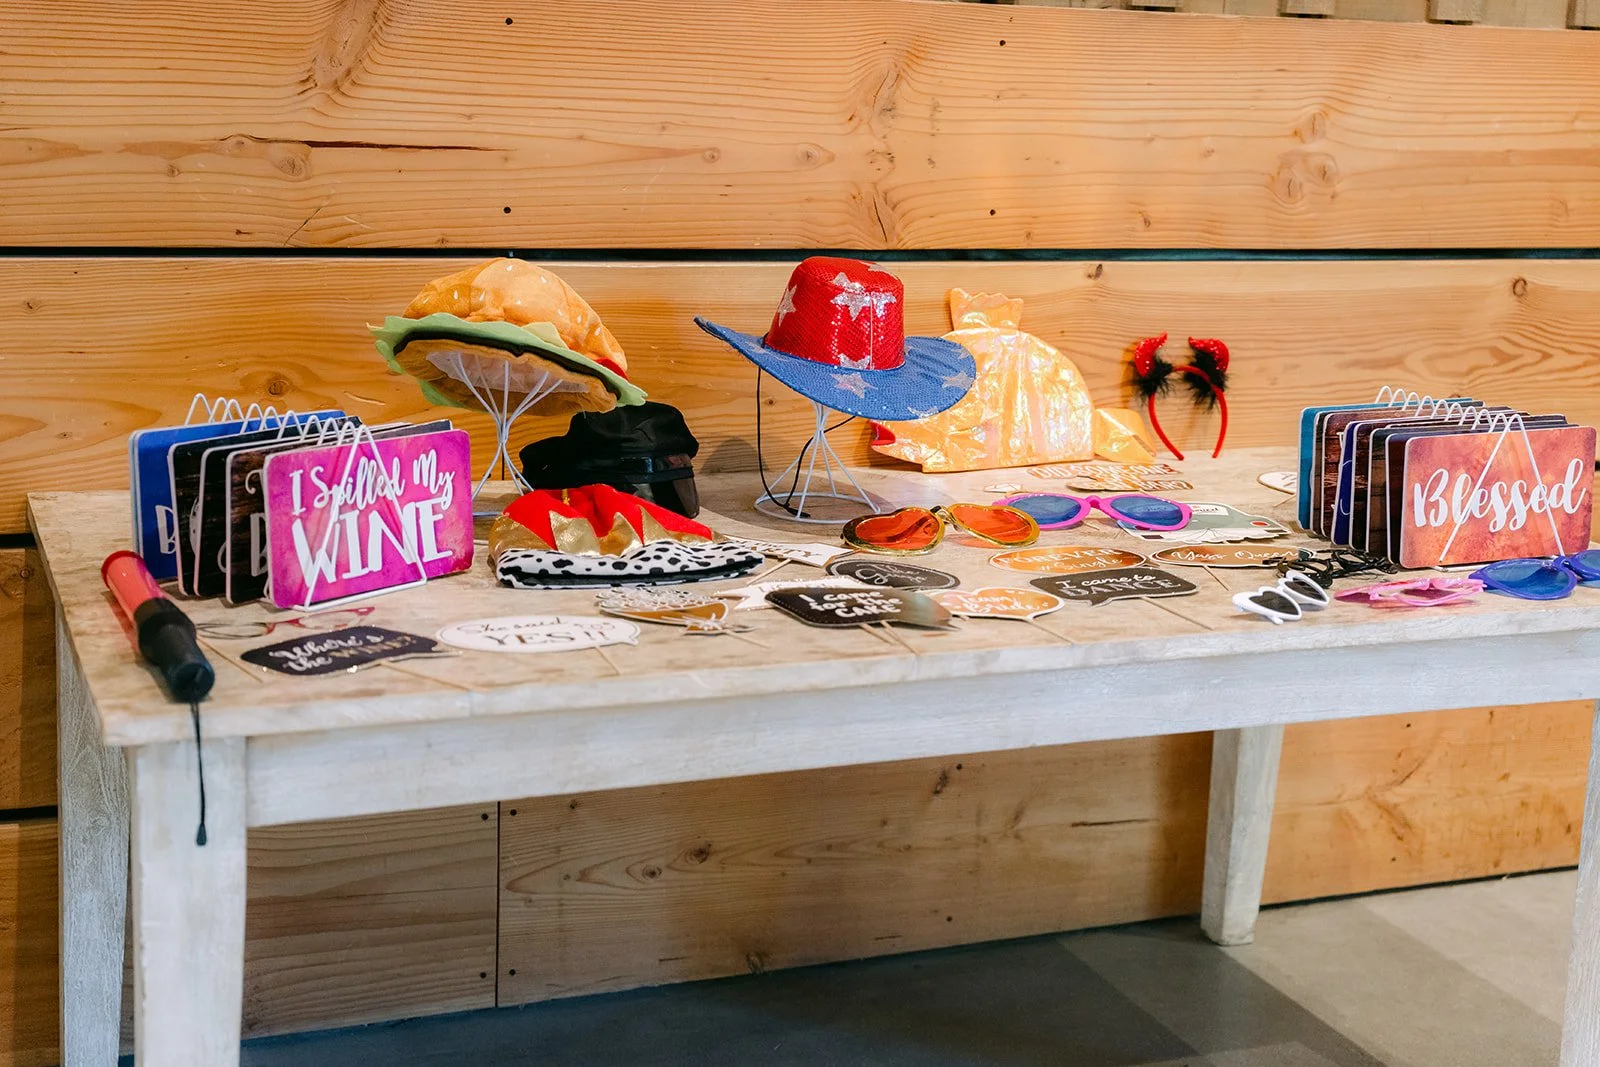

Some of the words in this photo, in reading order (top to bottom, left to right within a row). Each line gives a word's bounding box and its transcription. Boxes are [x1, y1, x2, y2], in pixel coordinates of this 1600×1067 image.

[1032, 466, 1073, 478] DID
[289, 469, 307, 516] I
[310, 456, 406, 509] Spilled
[413, 449, 455, 511] My
[1414, 458, 1587, 533] Blessed
[291, 498, 454, 588] WINE
[997, 548, 1122, 565] FOREVER
[1056, 580, 1073, 589] I
[1081, 576, 1131, 586] came
[1132, 573, 1157, 583] to
[1058, 579, 1181, 597] DANCE
[799, 594, 811, 603] I
[822, 590, 885, 602] came
[809, 600, 848, 612] for
[856, 595, 903, 607] the
[835, 603, 903, 619] CAKE
[282, 654, 334, 672] the
